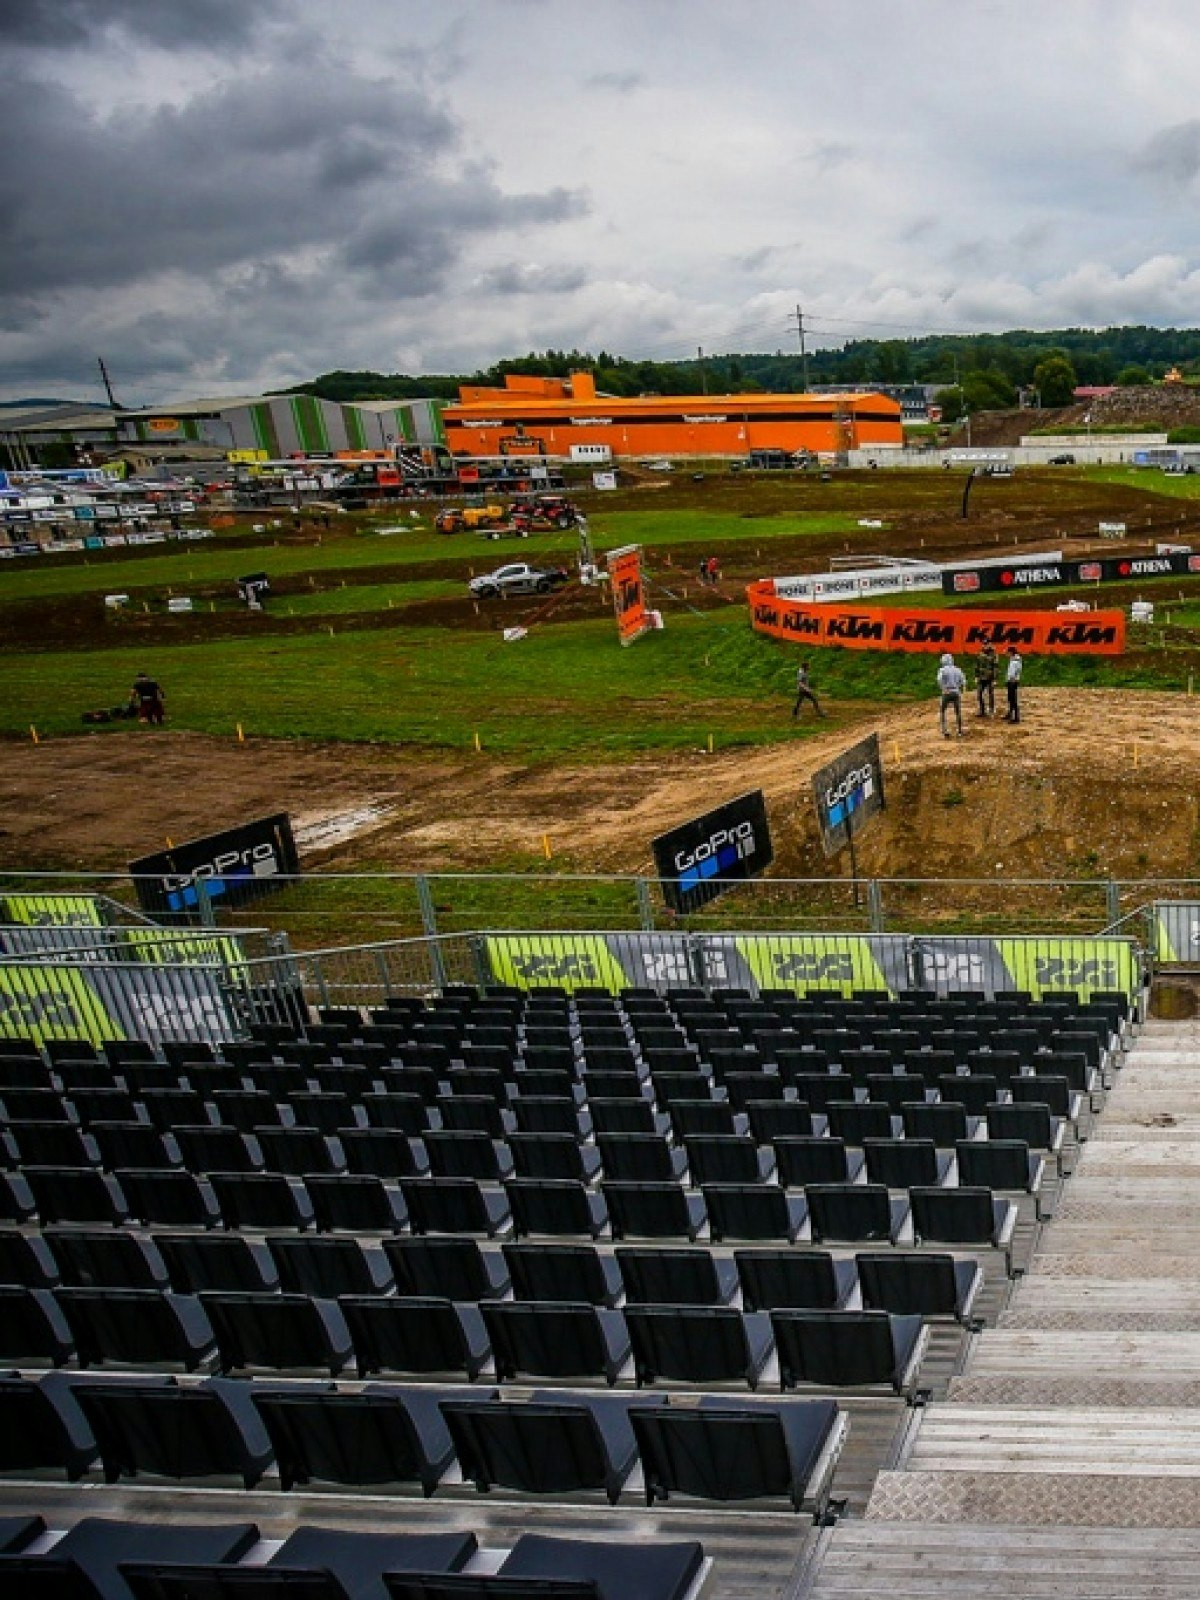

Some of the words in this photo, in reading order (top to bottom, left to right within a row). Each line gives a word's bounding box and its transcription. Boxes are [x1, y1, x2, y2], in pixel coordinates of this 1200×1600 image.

[1013, 567, 1062, 583] ATHENA
[1130, 559, 1173, 573] ATHENA
[782, 609, 820, 635] KTM
[826, 614, 884, 641] KTM
[890, 618, 955, 643] KTM
[965, 621, 1035, 644] KTM
[1045, 621, 1117, 645] KTM
[825, 763, 873, 807] GoPro
[674, 819, 753, 871] GoPro
